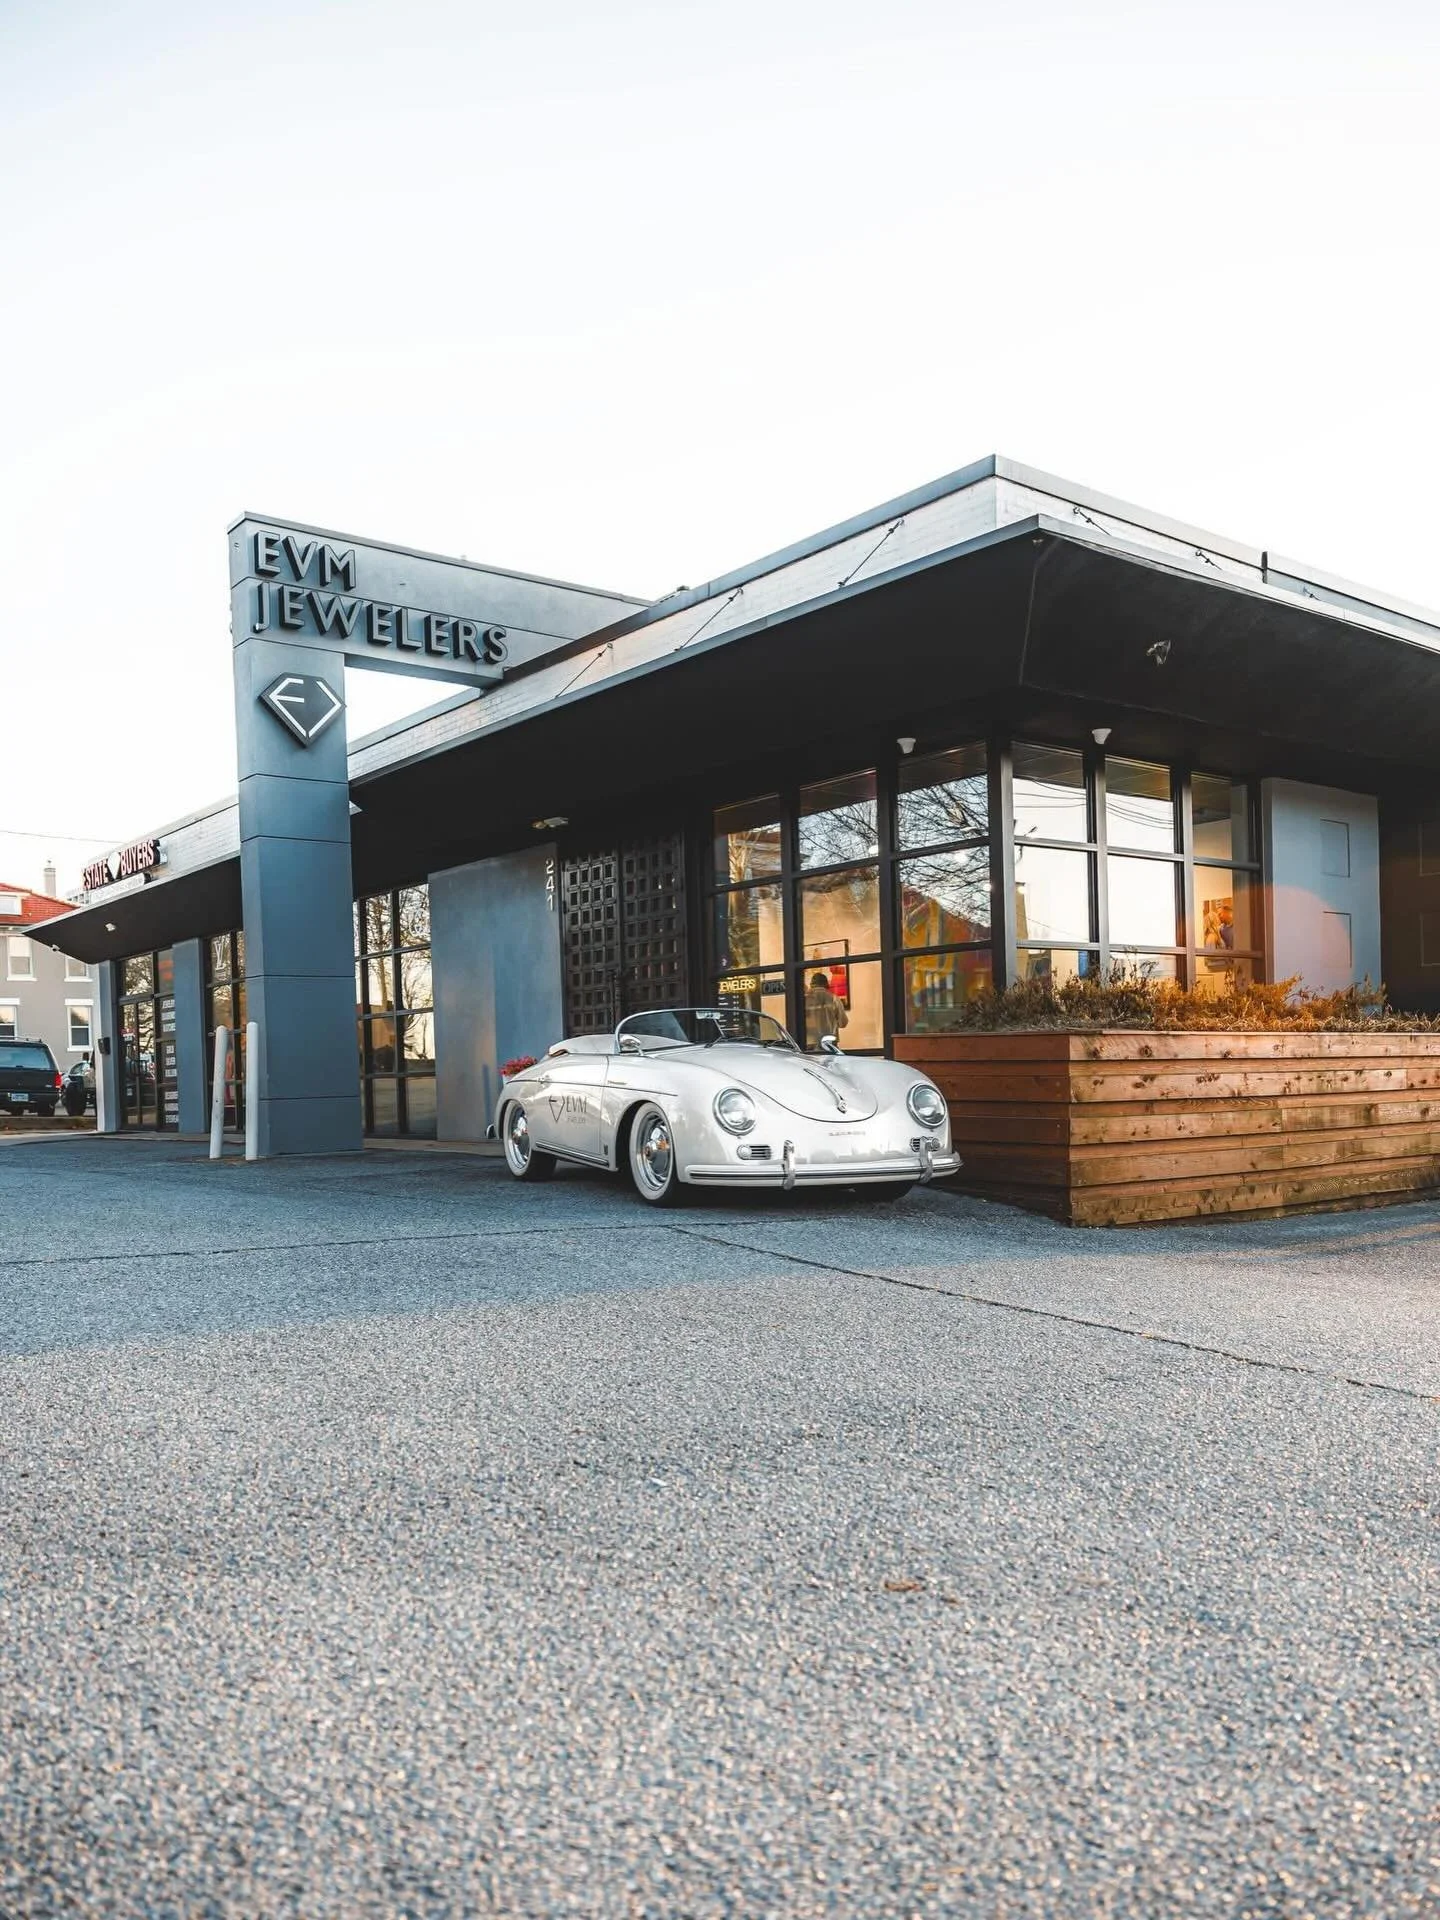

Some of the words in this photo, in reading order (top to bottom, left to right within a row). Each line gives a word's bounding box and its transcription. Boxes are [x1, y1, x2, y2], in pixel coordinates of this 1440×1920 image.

[255, 531, 356, 591] EVM
[253, 581, 509, 663] JEWELERS
[120, 840, 154, 876] BUYERS
[546, 859, 555, 911] 241
[719, 979, 756, 992] JEWELERS
